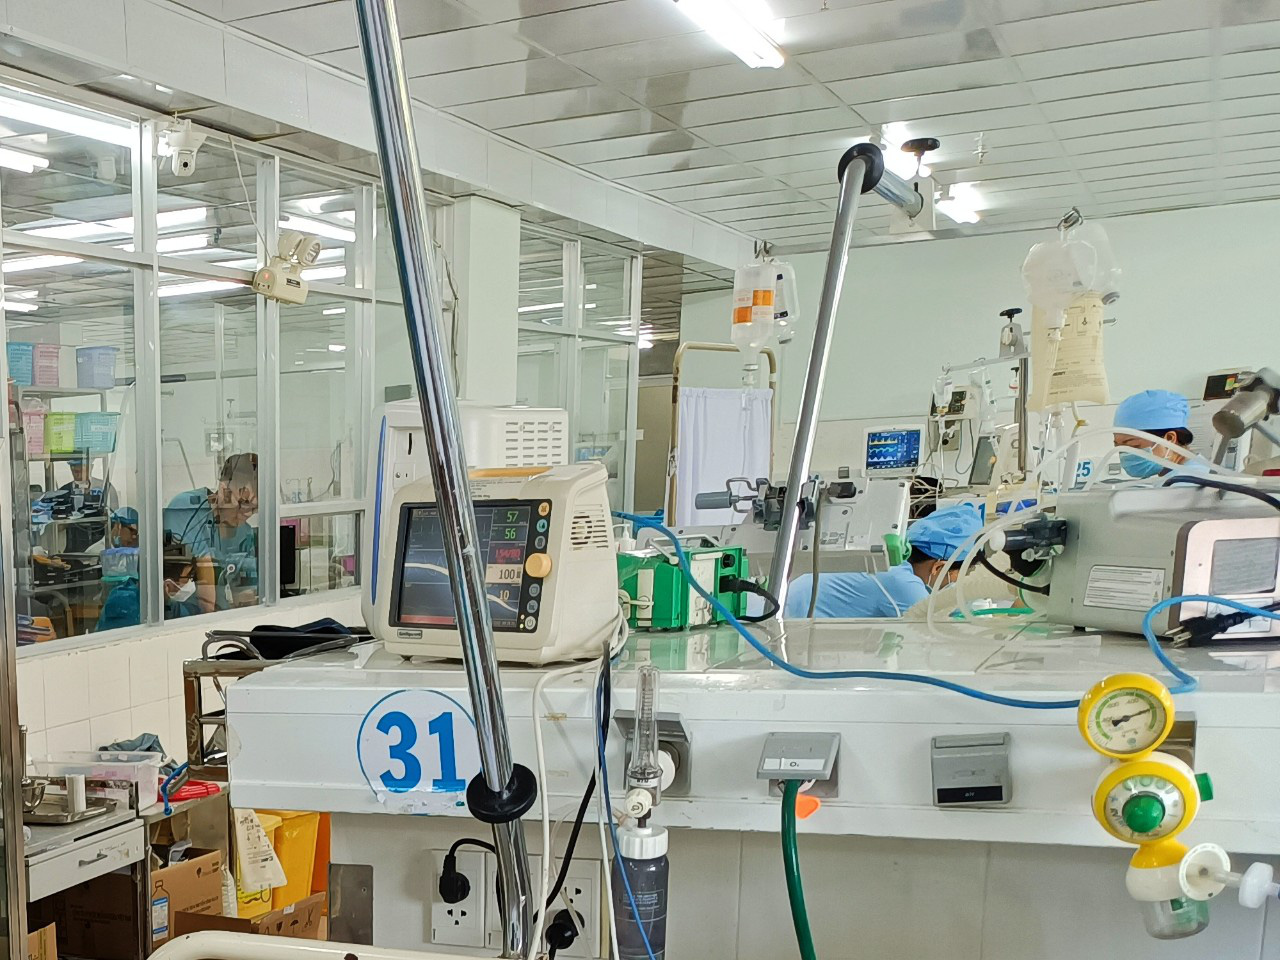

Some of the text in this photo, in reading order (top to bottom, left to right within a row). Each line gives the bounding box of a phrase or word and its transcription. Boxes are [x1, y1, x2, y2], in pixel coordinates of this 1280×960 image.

[506, 511, 519, 522] 57
[504, 528, 516, 540] 56
[499, 568, 515, 580] 100
[375, 711, 466, 793] 31
